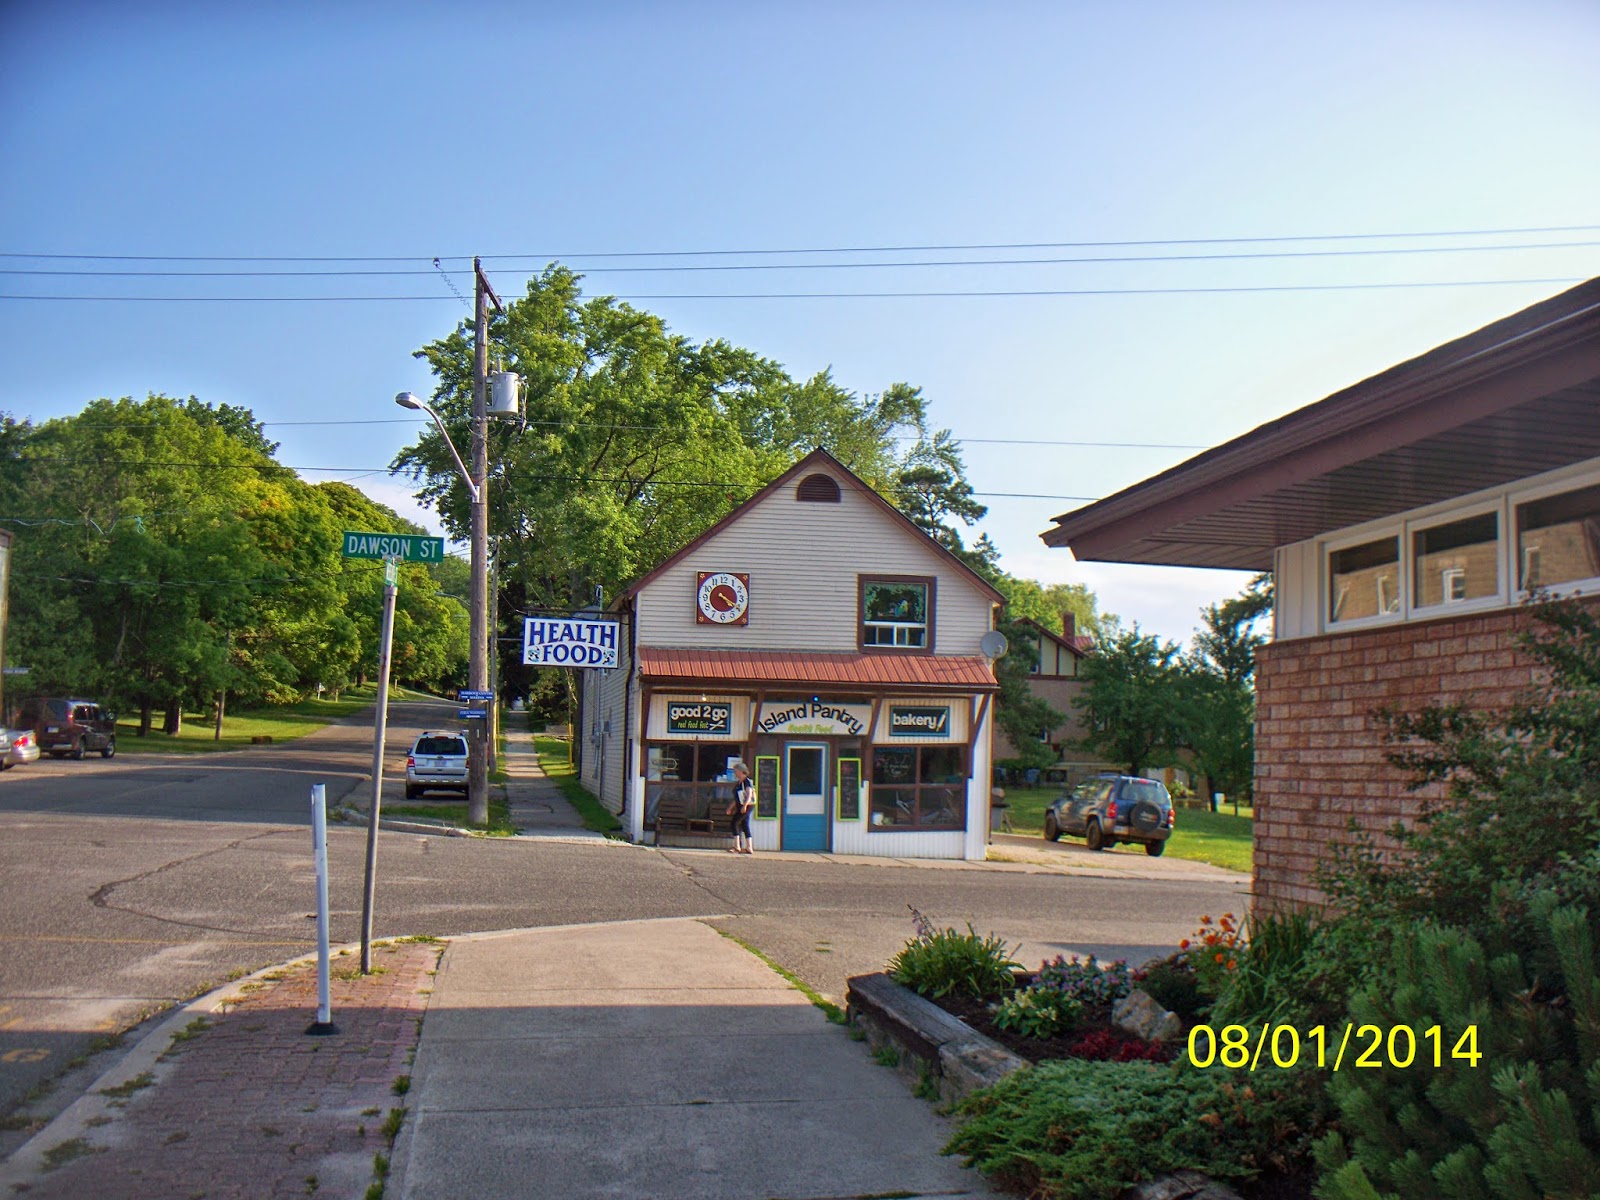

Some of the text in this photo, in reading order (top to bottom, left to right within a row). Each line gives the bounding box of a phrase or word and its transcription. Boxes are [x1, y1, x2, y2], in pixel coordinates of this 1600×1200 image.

[348, 536, 438, 558] DAWSON ST
[720, 576, 728, 584] 12
[704, 603, 710, 611] 8
[528, 621, 616, 649] HEALTH
[542, 643, 603, 664] FOOD
[671, 705, 728, 721] good 2 go
[758, 702, 864, 735] Island Pantry
[893, 713, 937, 729] bakery
